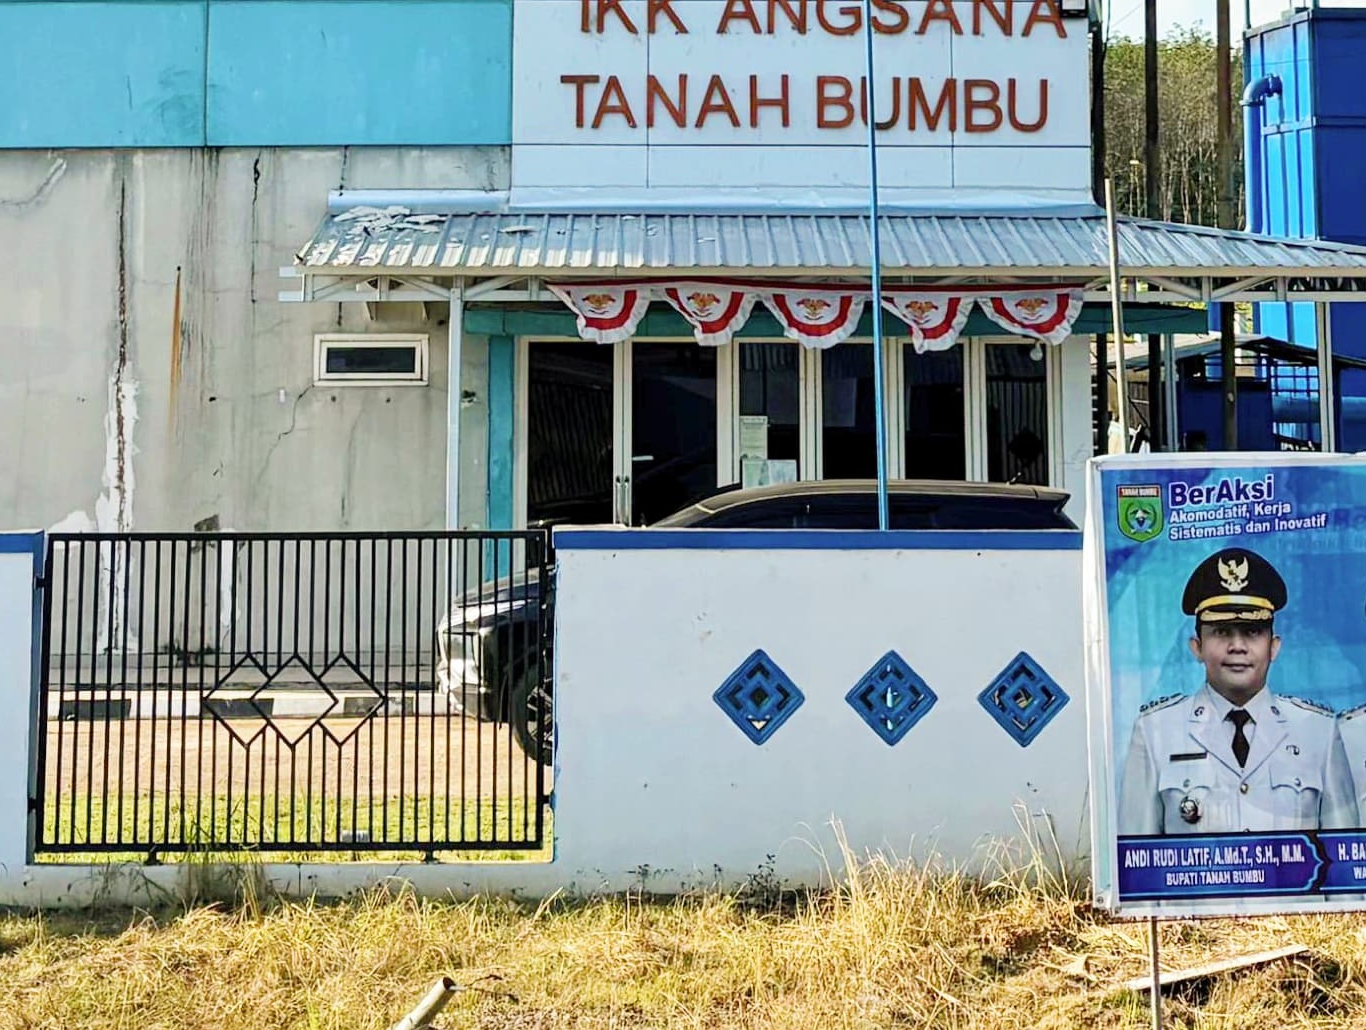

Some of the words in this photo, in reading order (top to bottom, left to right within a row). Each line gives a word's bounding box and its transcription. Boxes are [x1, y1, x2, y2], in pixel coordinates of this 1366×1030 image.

[560, 74, 790, 129] TANAH
[817, 75, 1049, 133] BUMBU
[1170, 476, 1273, 507] BerAksi
[1170, 504, 1250, 524] Akomodatif,
[1254, 501, 1291, 517] Kerja
[1170, 522, 1242, 541] Sistematis
[1246, 521, 1270, 533] dan
[1275, 514, 1326, 531] Inovatif
[1124, 850, 1150, 868] ANDI
[1153, 849, 1177, 867] RUDI
[1181, 848, 1212, 868] LATIF,
[1281, 844, 1305, 863] M.M.
[1338, 843, 1350, 861] H.
[1166, 872, 1198, 886] BUPATI
[1200, 871, 1231, 885] TANAH
[1233, 870, 1265, 883] BUMBU
